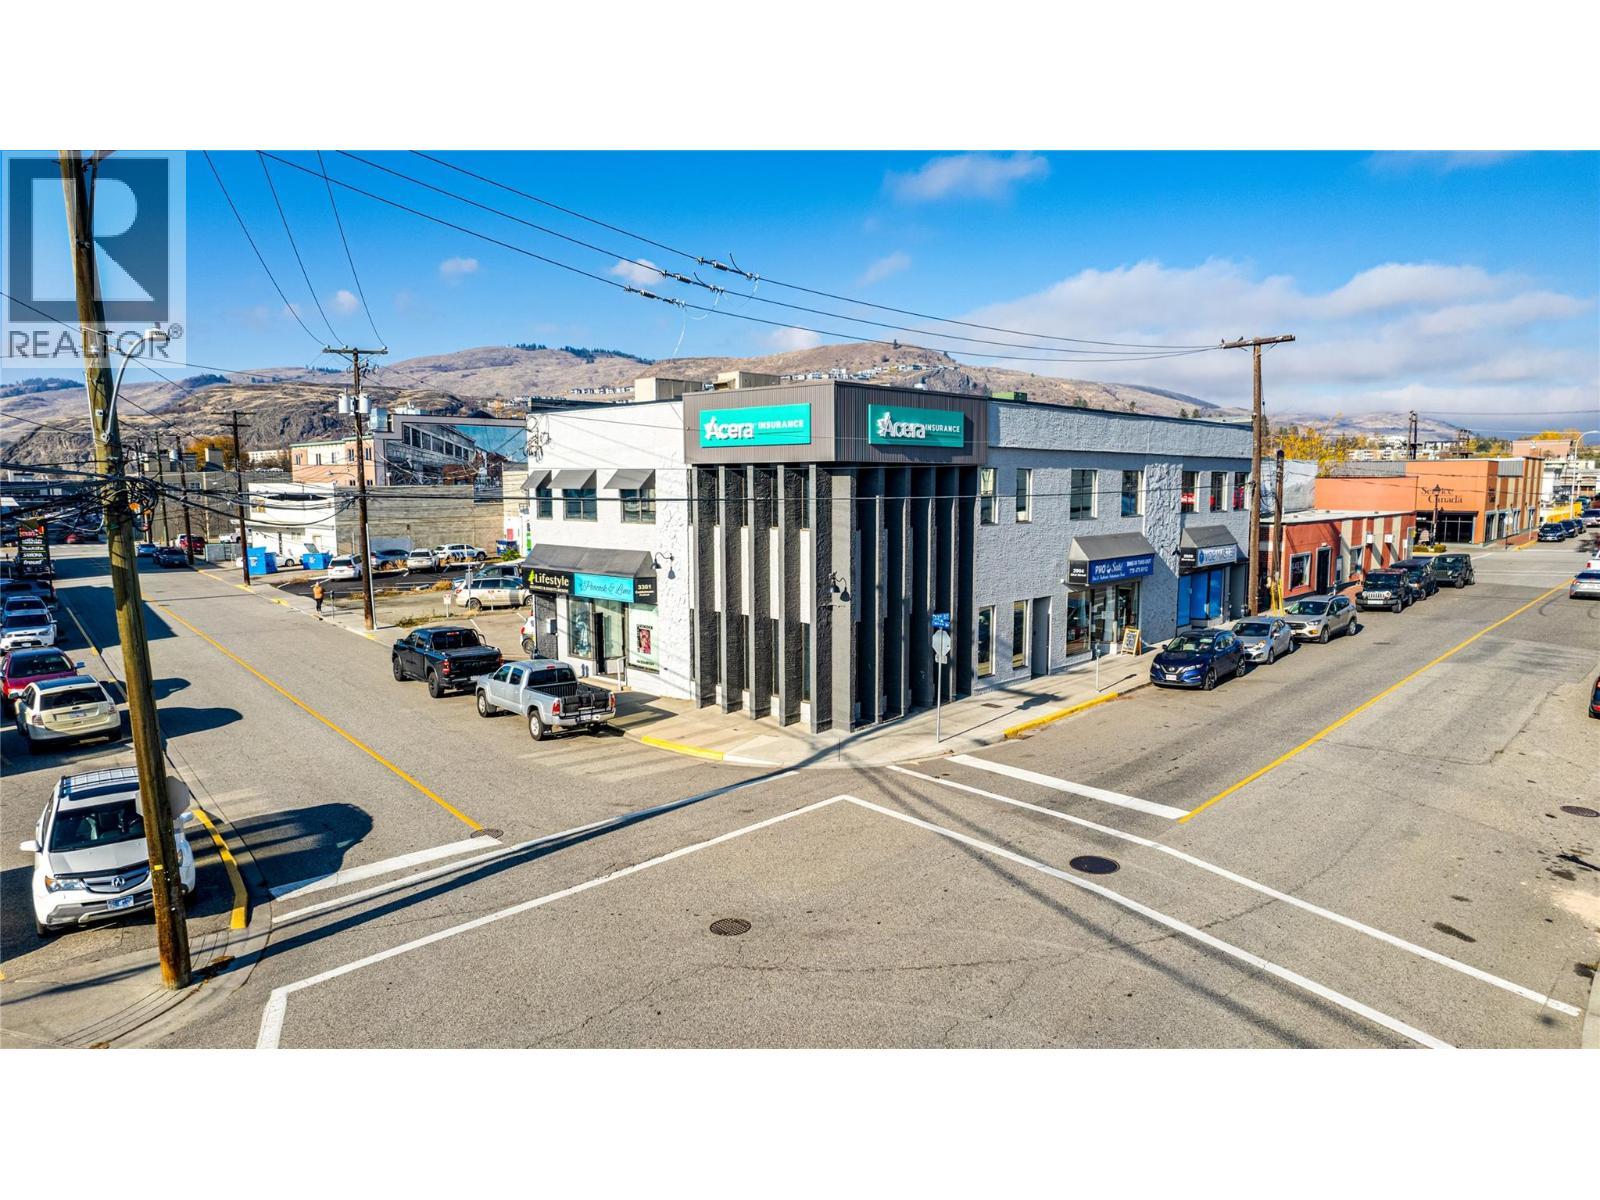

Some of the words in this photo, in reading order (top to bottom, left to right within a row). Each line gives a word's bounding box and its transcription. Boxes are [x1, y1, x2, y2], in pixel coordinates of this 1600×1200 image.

[704, 416, 754, 440] Acera
[758, 420, 804, 429] INSURANCE
[878, 411, 926, 439] Acera
[534, 573, 569, 588] Lifestyle
